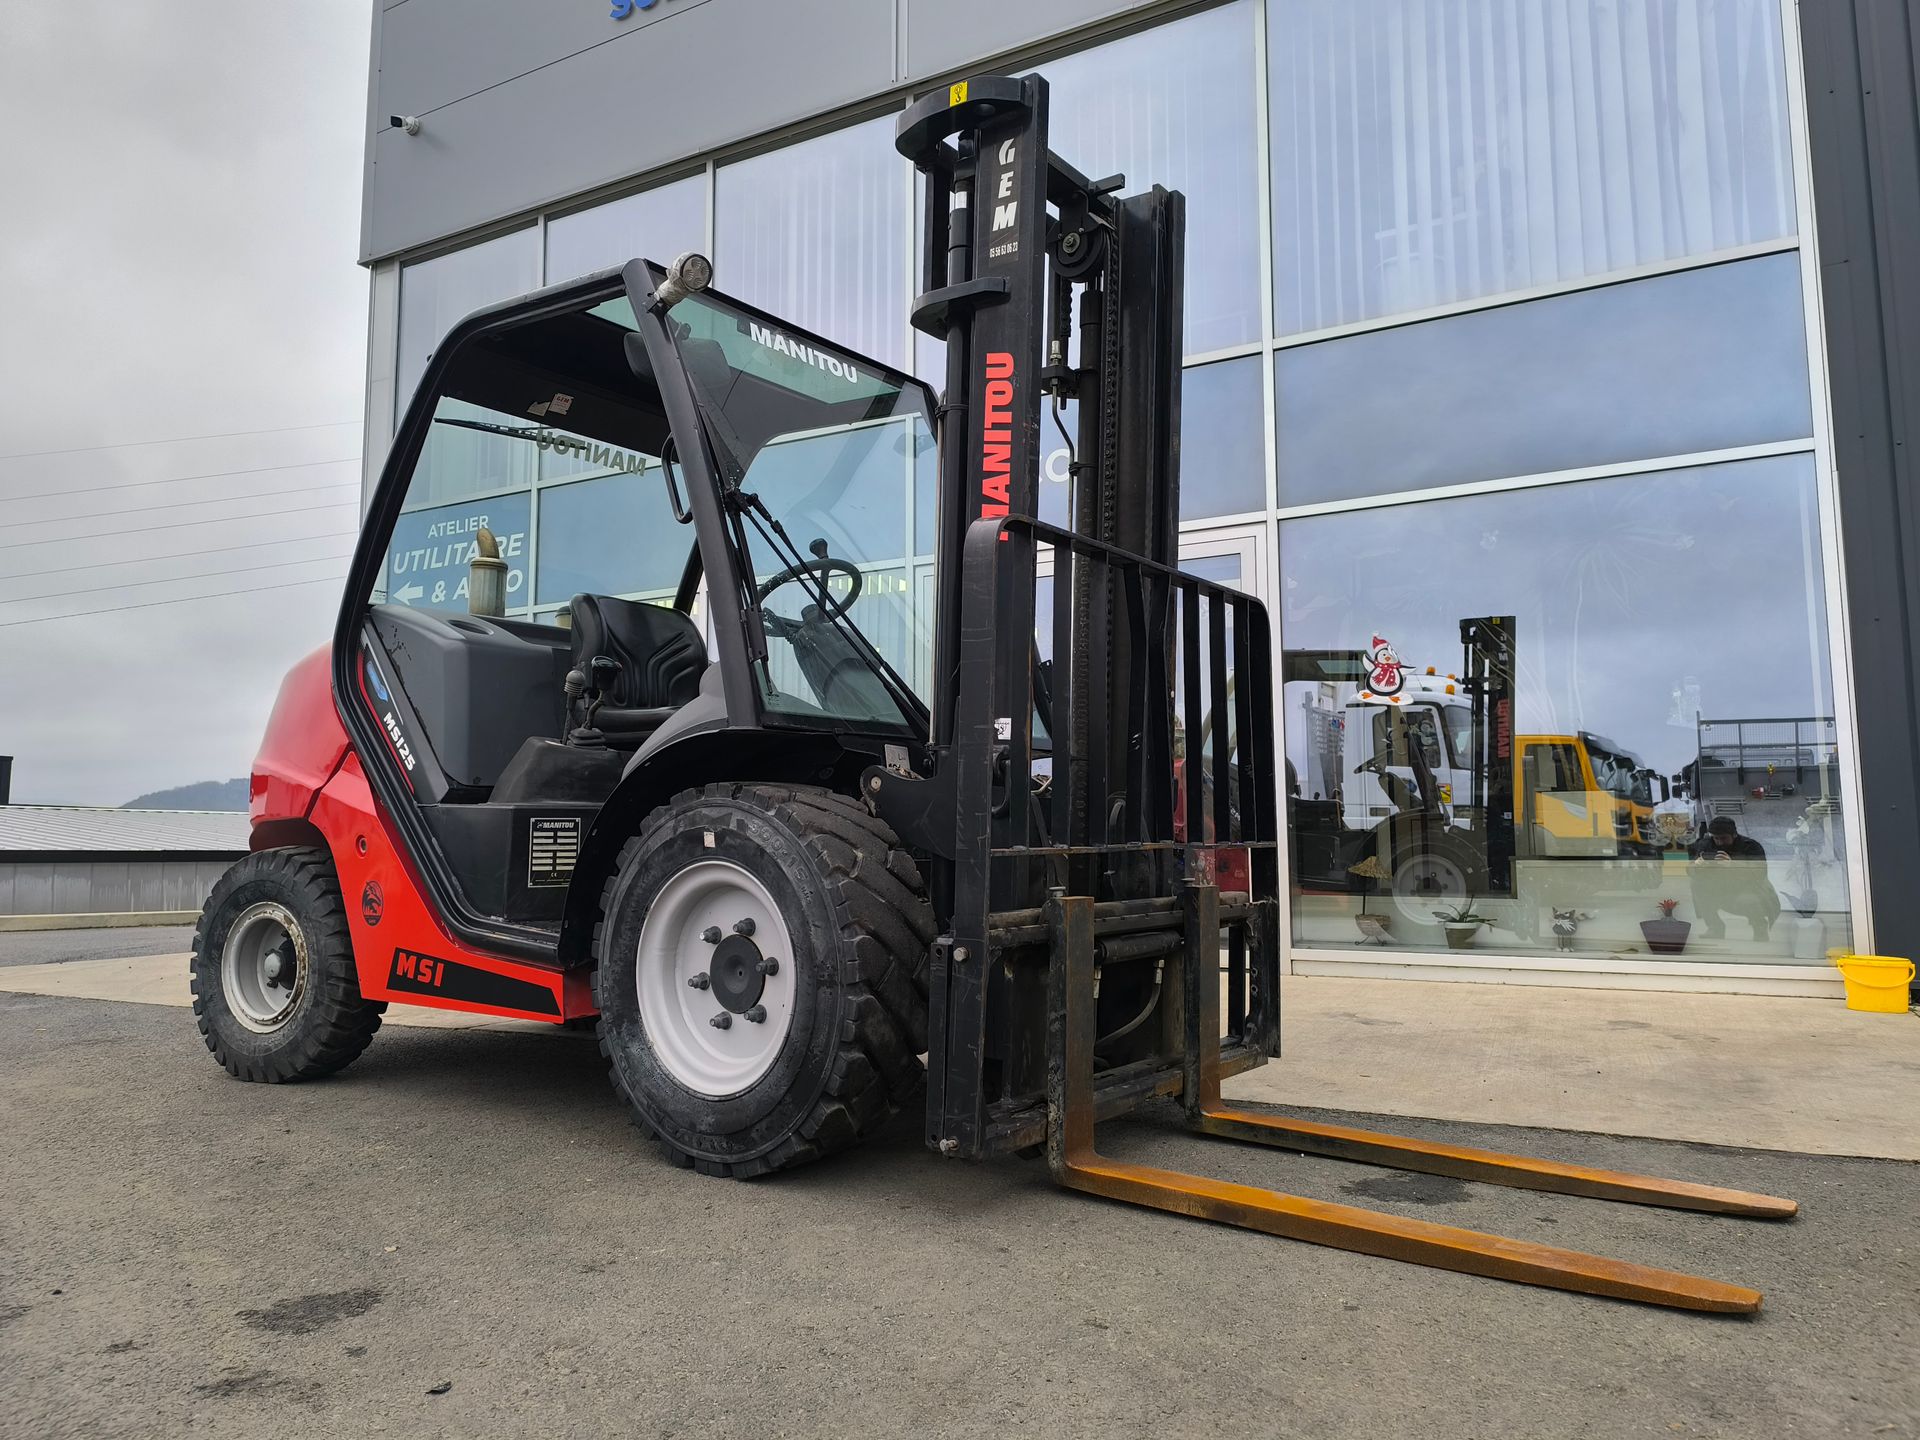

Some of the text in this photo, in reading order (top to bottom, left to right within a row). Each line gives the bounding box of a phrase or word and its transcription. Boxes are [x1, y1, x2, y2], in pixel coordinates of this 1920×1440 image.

[992, 138, 1018, 231] GEM
[749, 322, 858, 384] MANITOU
[428, 515, 489, 539] ATELIER
[393, 533, 525, 575] UTILITARE
[431, 580, 446, 603] &
[383, 711, 416, 771] MSI25
[543, 821, 575, 829] MANITOU
[396, 952, 445, 988] MSI
